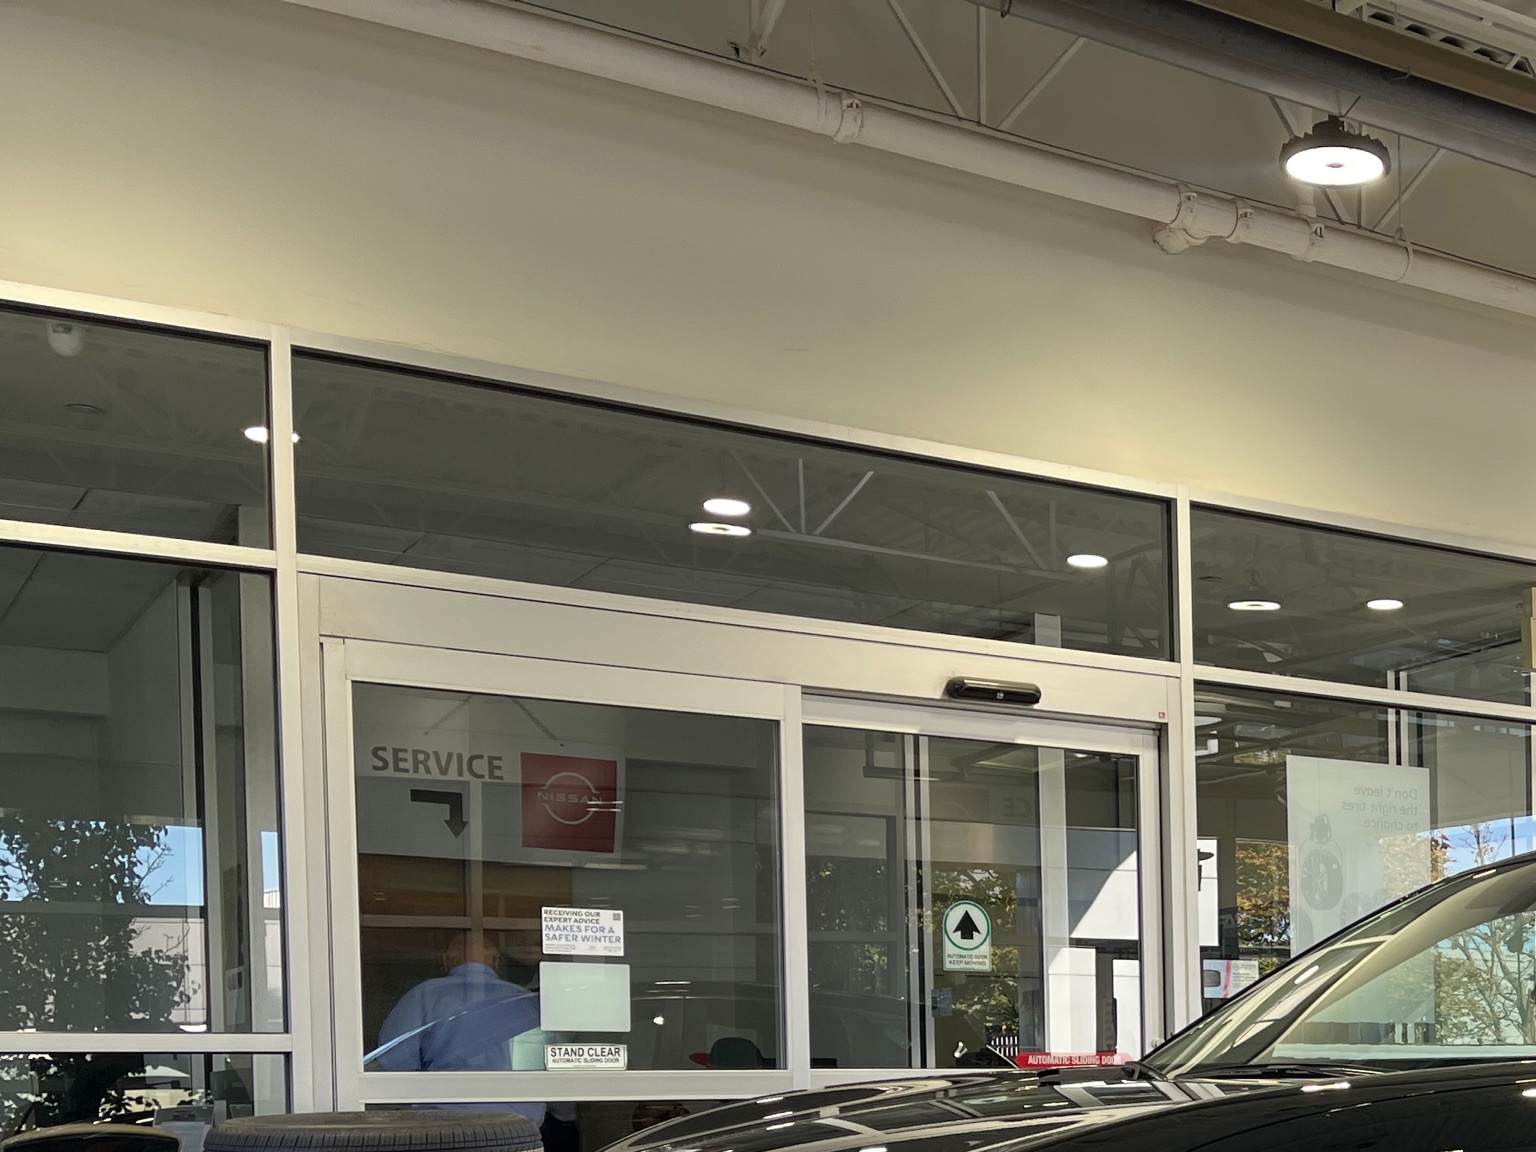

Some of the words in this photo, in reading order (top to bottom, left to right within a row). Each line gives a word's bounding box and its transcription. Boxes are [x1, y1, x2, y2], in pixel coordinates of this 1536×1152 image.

[371, 746, 504, 780] SERVICE
[537, 790, 602, 804] NISSAN
[545, 924, 582, 932] MAKES
[545, 933, 578, 942] SAFER
[581, 935, 621, 943] WINTER
[551, 1048, 584, 1057] STAND
[588, 1048, 620, 1057] CLEAR
[1028, 1055, 1071, 1064] AUTOMATIC
[1072, 1055, 1100, 1064] SLIDING
